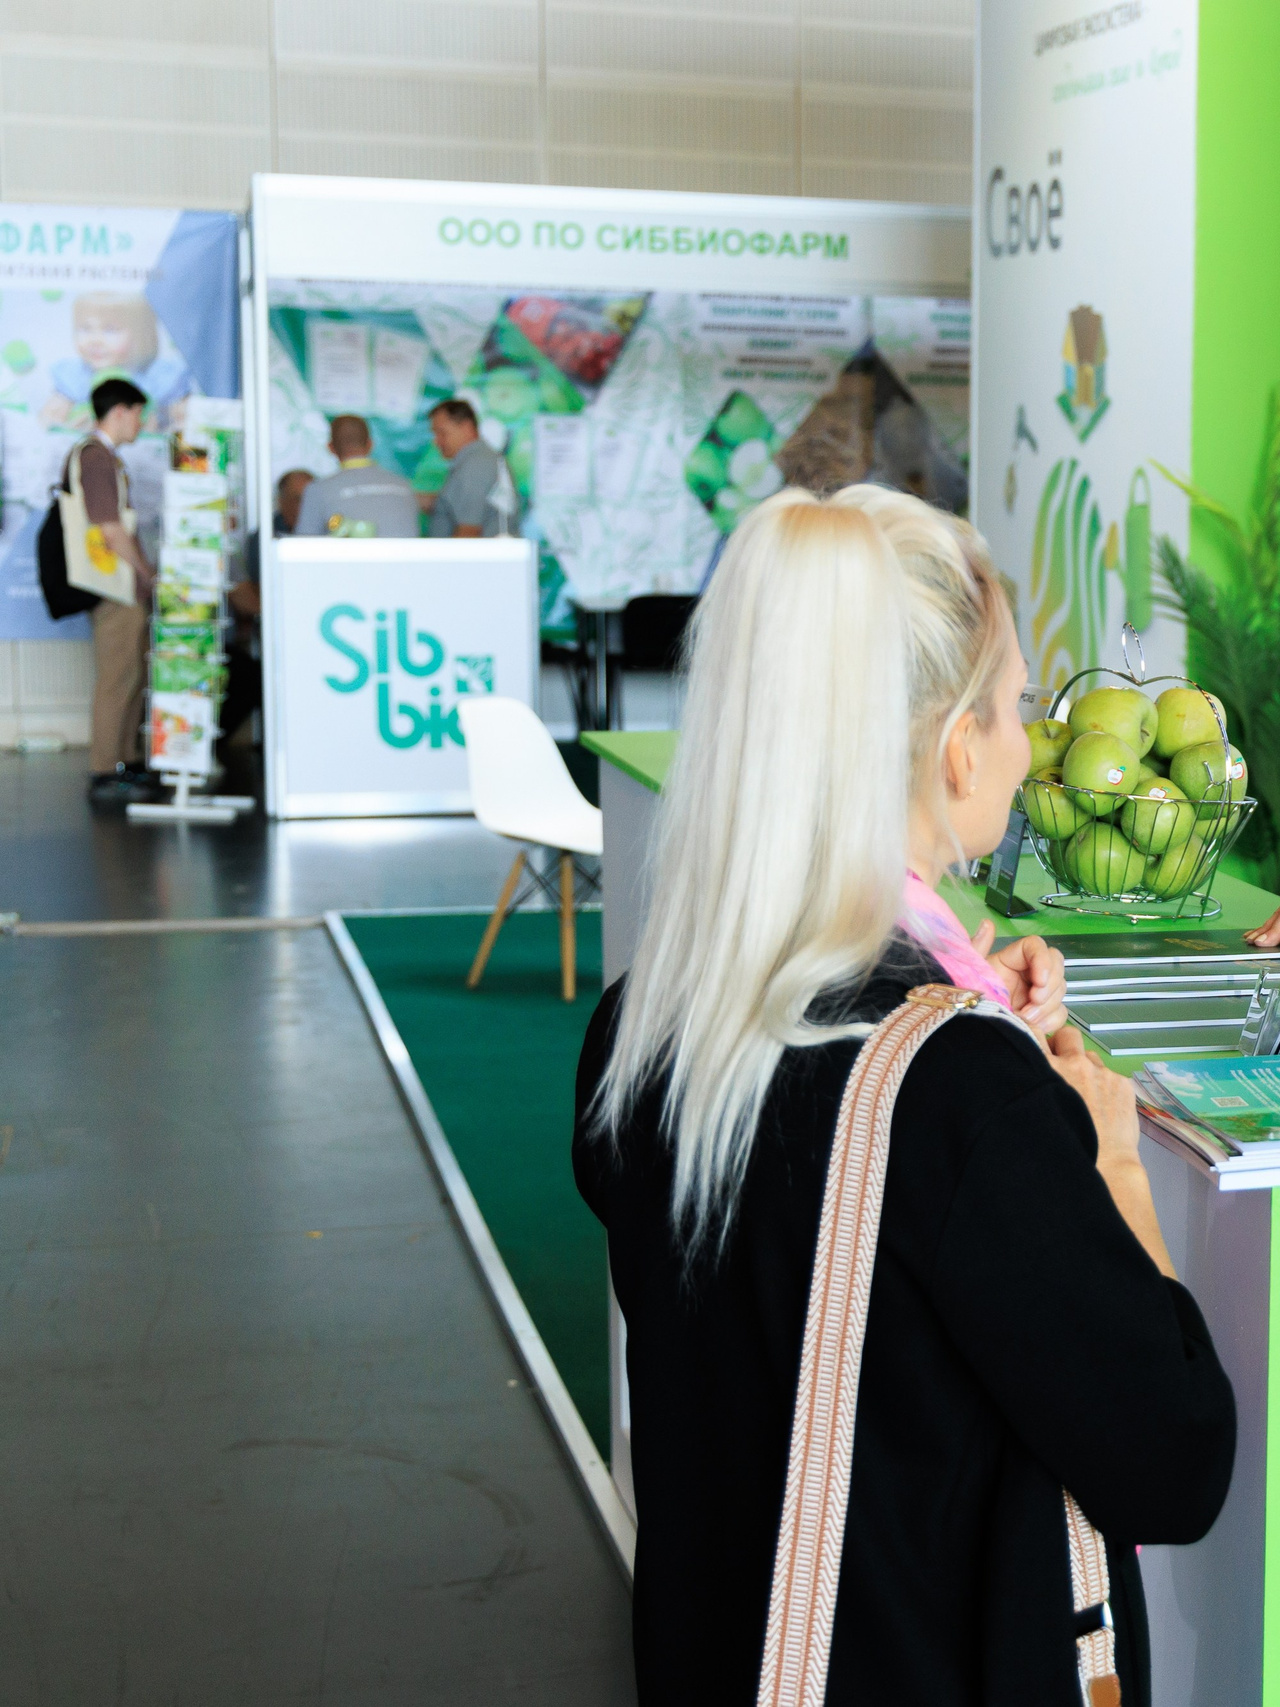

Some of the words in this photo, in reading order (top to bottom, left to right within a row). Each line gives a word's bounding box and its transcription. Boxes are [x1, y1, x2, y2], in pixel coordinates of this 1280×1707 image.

[438, 216, 522, 248] ООО
[533, 220, 585, 250] ПО
[595, 223, 849, 260] СИББИОФАРМ
[986, 149, 1064, 258] Своё
[319, 604, 445, 693] Sib
